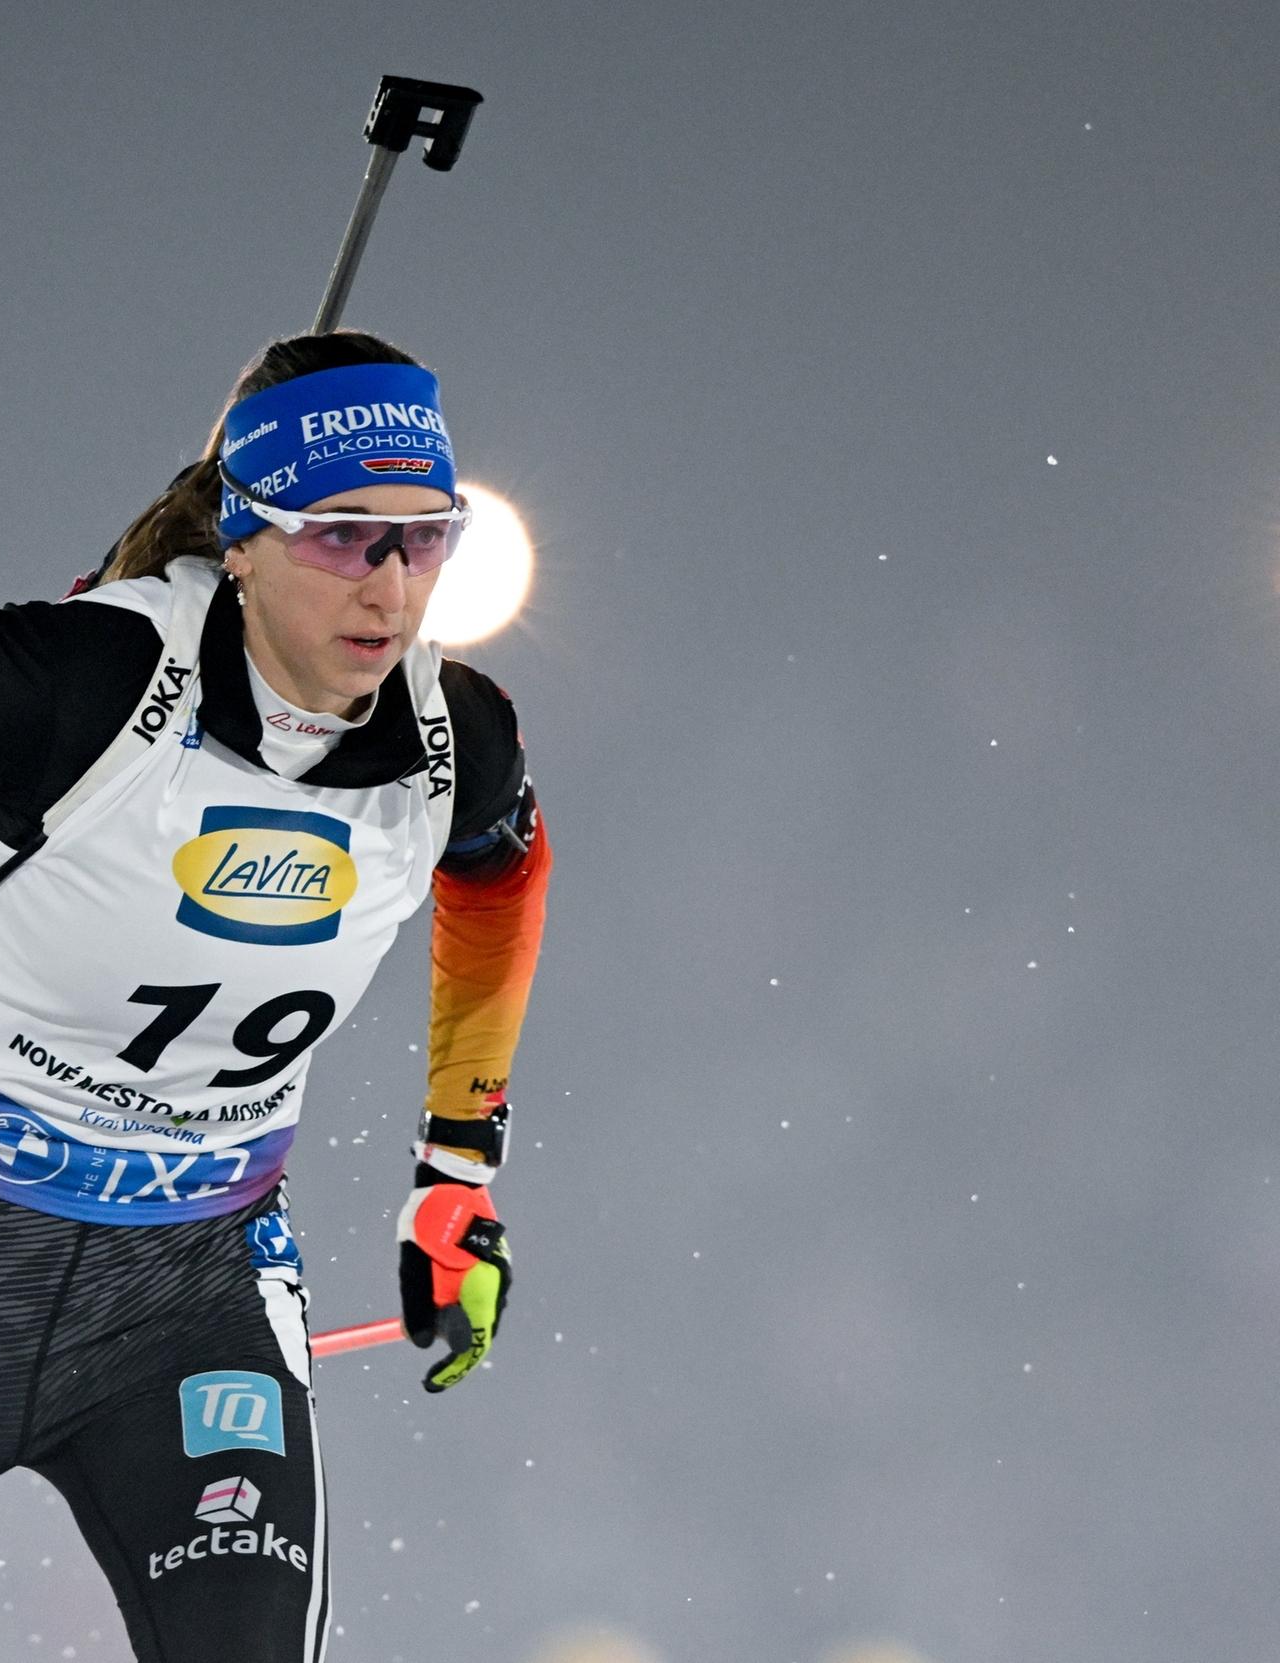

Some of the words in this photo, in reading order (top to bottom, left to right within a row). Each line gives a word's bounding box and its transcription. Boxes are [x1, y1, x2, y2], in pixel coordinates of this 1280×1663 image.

[131, 664, 193, 746] JOKA
[420, 715, 452, 800] JOKA
[195, 1382, 270, 1442] TQ
[148, 1522, 309, 1580] tectake
